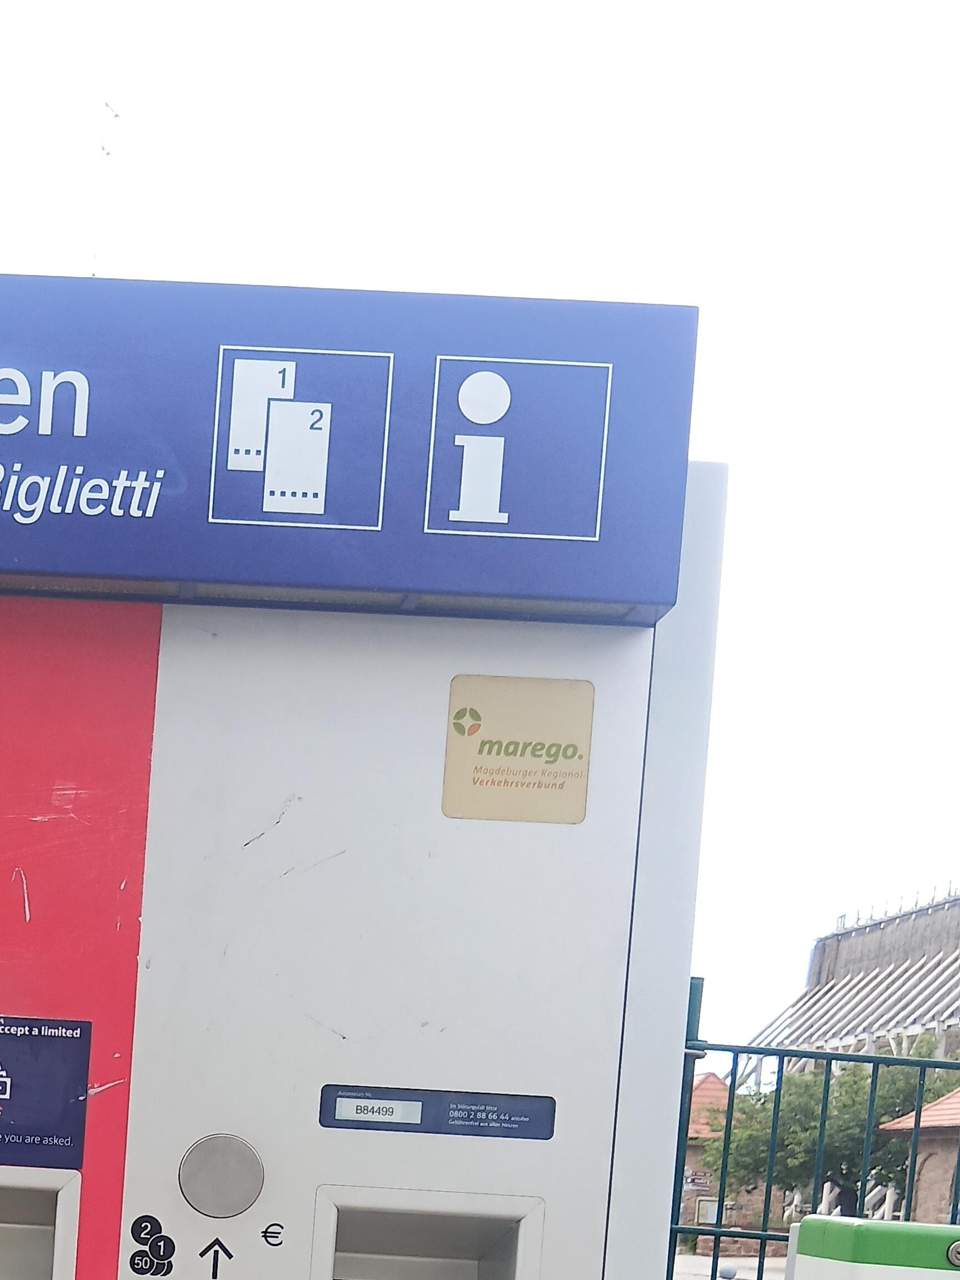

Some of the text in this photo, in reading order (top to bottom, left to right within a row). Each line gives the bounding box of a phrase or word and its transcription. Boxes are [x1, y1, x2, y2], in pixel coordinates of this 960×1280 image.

[276, 366, 289, 391] 1
[308, 408, 325, 432] 2
[473, 766, 538, 778] Magdeburger
[472, 777, 566, 790] Verkehrsverbund
[41, 1025, 81, 1038] limited
[355, 1105, 394, 1117] B84499
[449, 1110, 467, 1119] 0800
[469, 1111, 475, 1119] 2
[476, 1111, 487, 1120] 88
[488, 1112, 498, 1120] 66
[4, 1133, 23, 1145] you
[25, 1136, 40, 1144] are
[42, 1134, 73, 1147] asked.
[141, 1223, 151, 1238] 2
[261, 1223, 284, 1247] €
[157, 1241, 164, 1255] 1
[134, 1257, 150, 1269] 50
